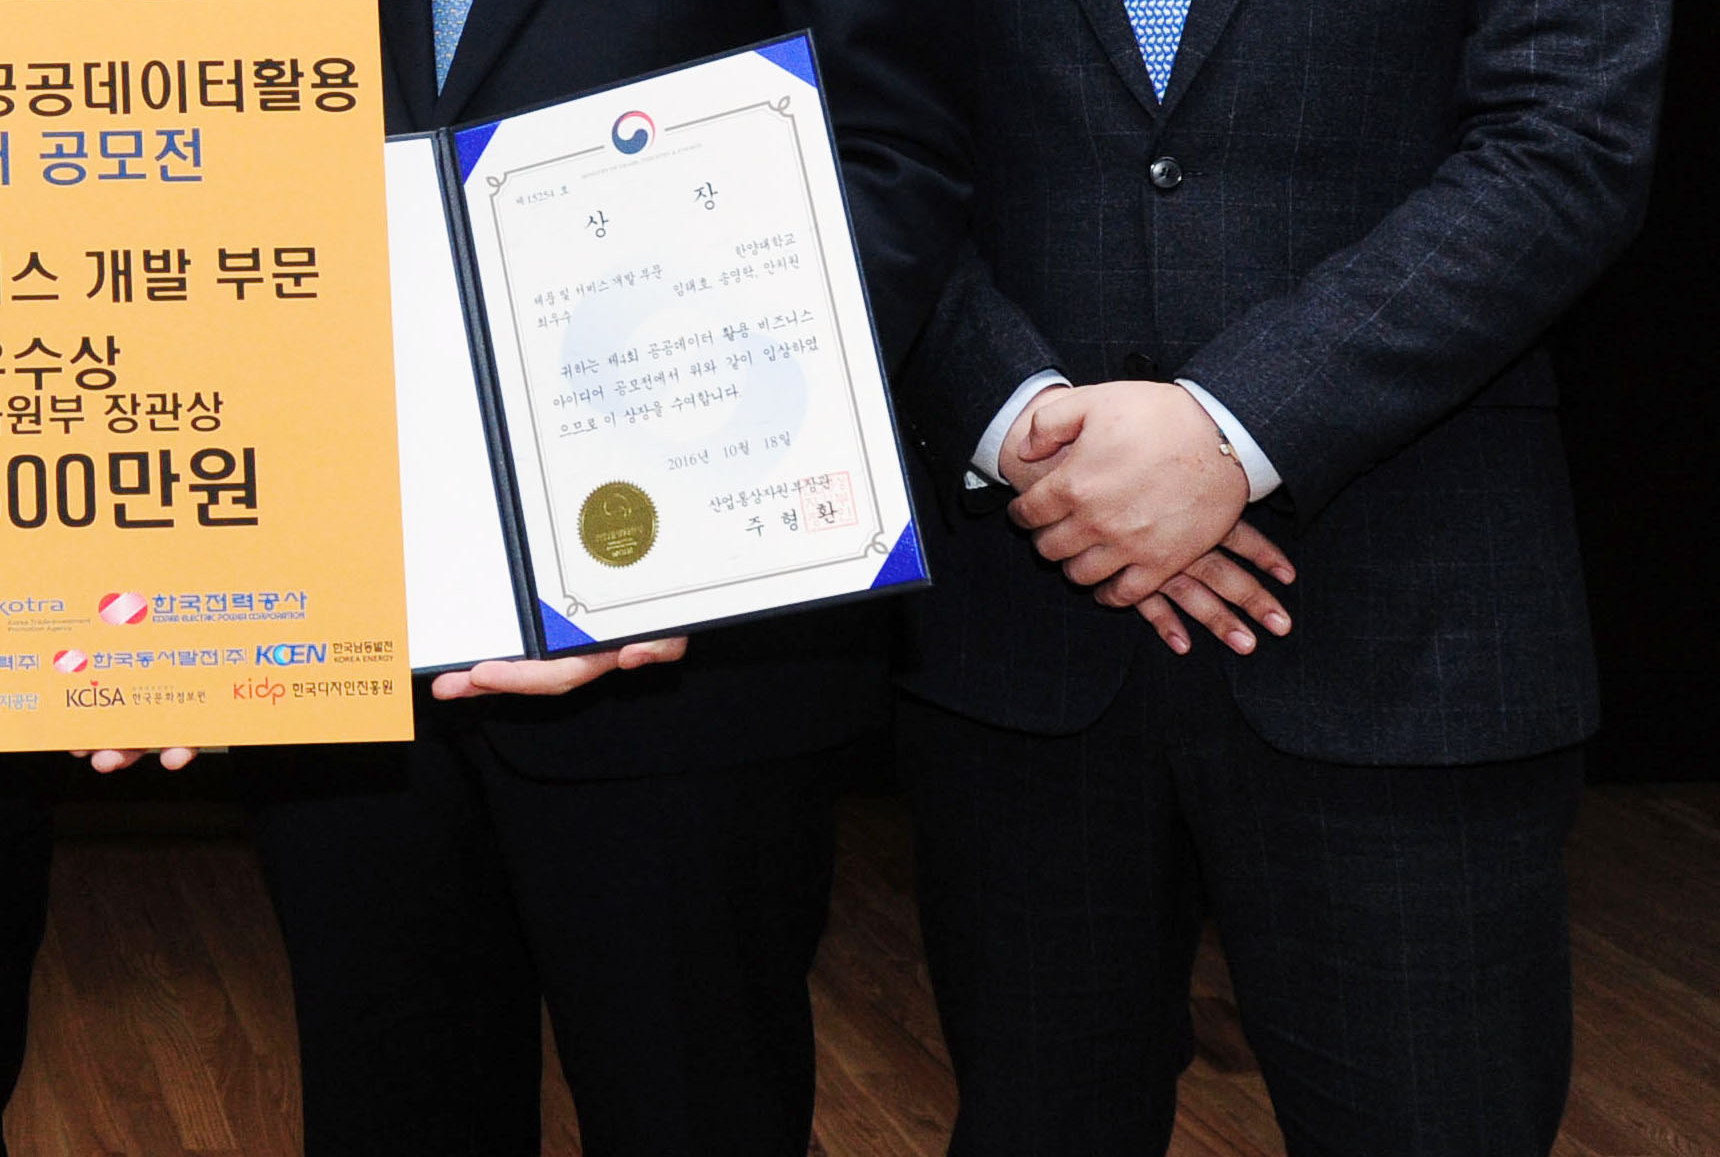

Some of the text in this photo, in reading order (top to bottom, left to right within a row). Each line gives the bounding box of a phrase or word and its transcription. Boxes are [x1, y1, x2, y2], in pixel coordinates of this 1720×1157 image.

[38, 126, 205, 184] 공모전
[585, 182, 718, 238] 상 장
[85, 247, 191, 303] 개발
[216, 246, 320, 300] 부문
[104, 391, 224, 433] 장관상
[152, 591, 308, 614] 한국전력공사
[292, 679, 393, 697] 한국디자인진흥원
